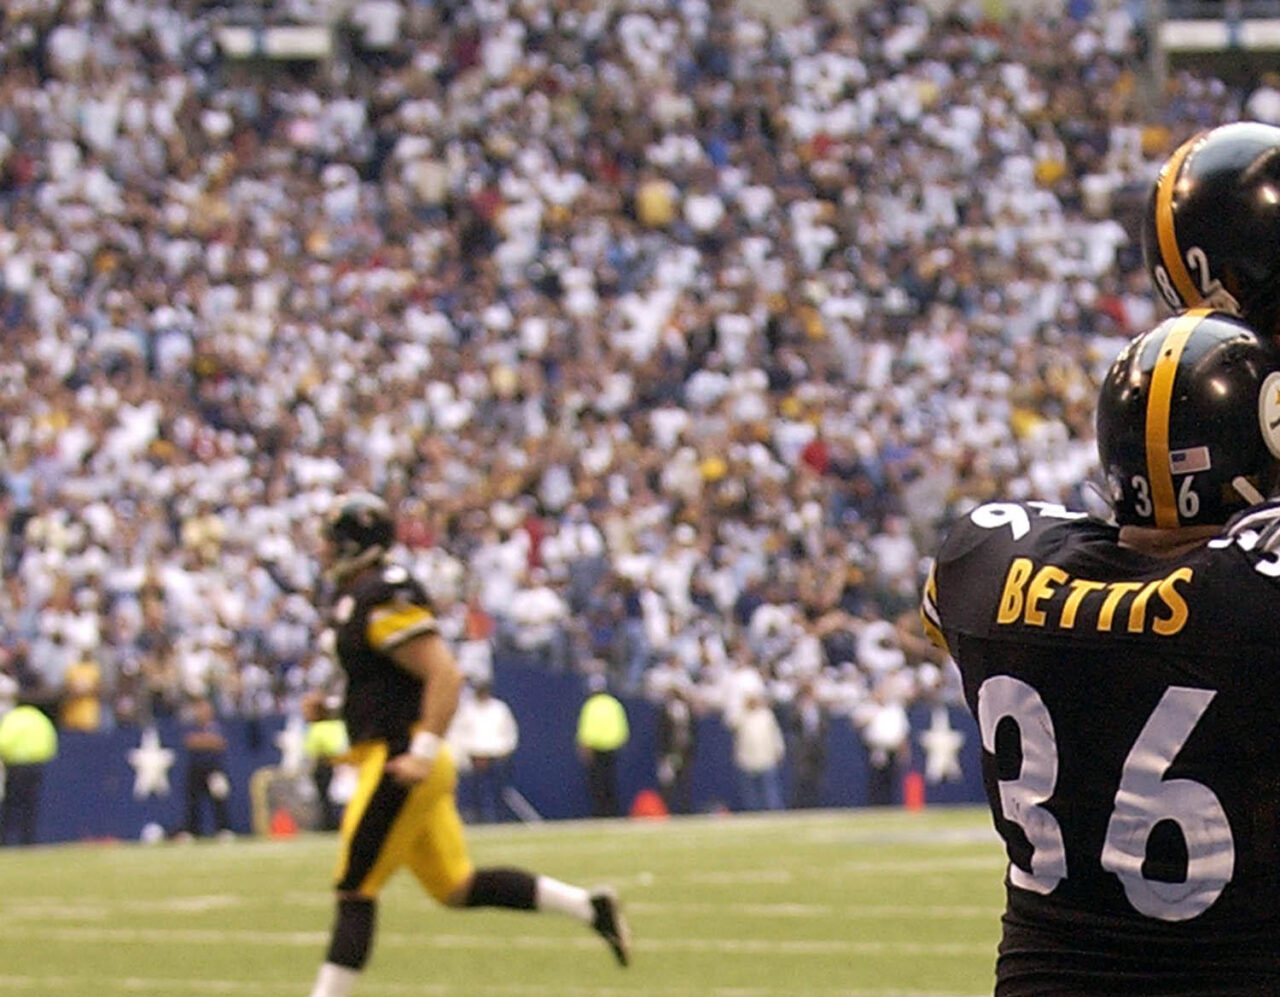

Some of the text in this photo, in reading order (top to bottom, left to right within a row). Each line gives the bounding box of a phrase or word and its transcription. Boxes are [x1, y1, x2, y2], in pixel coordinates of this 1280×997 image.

[1130, 474, 1201, 518] 36
[997, 557, 1194, 636] BETTIS
[977, 674, 1235, 923] 36
